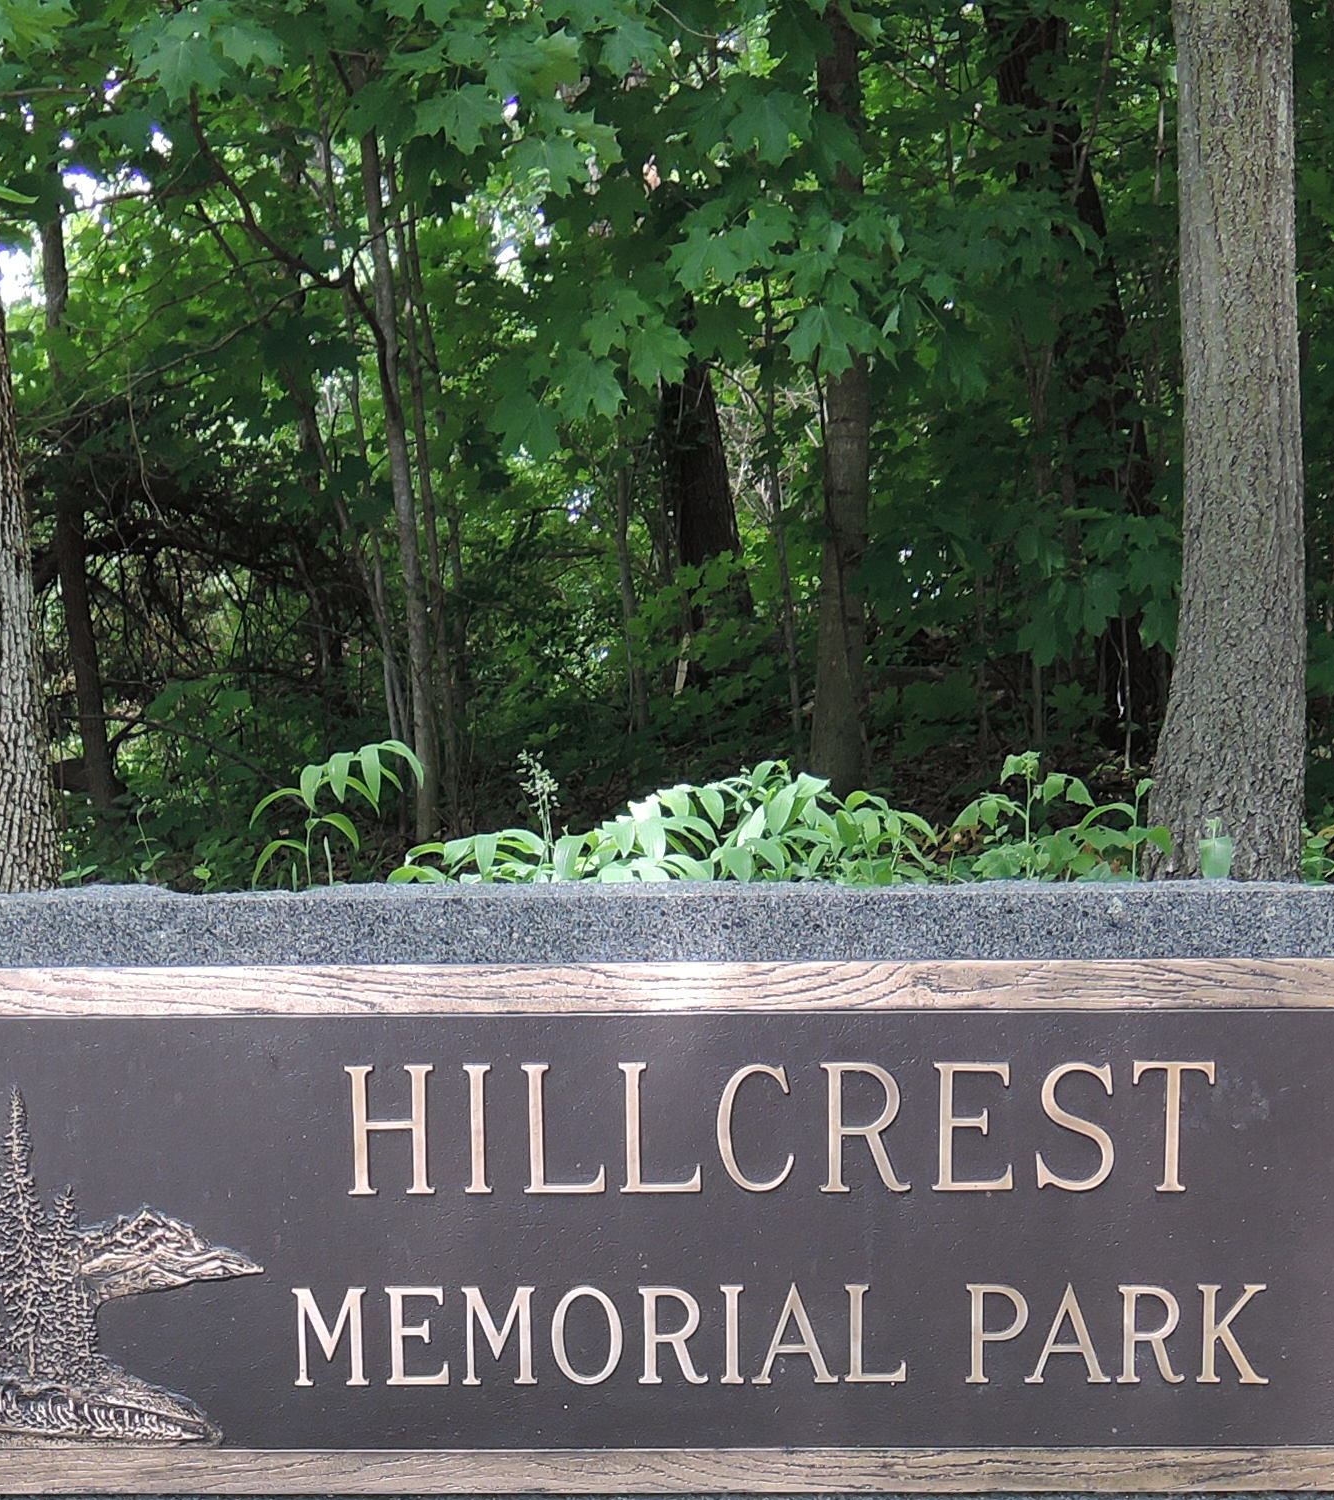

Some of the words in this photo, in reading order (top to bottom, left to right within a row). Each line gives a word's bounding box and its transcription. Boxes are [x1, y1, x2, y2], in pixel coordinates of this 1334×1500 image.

[343, 1060, 1216, 1195] HILLCREST
[290, 1282, 907, 1387] MEMORIAL
[965, 1282, 1269, 1384] PARK
